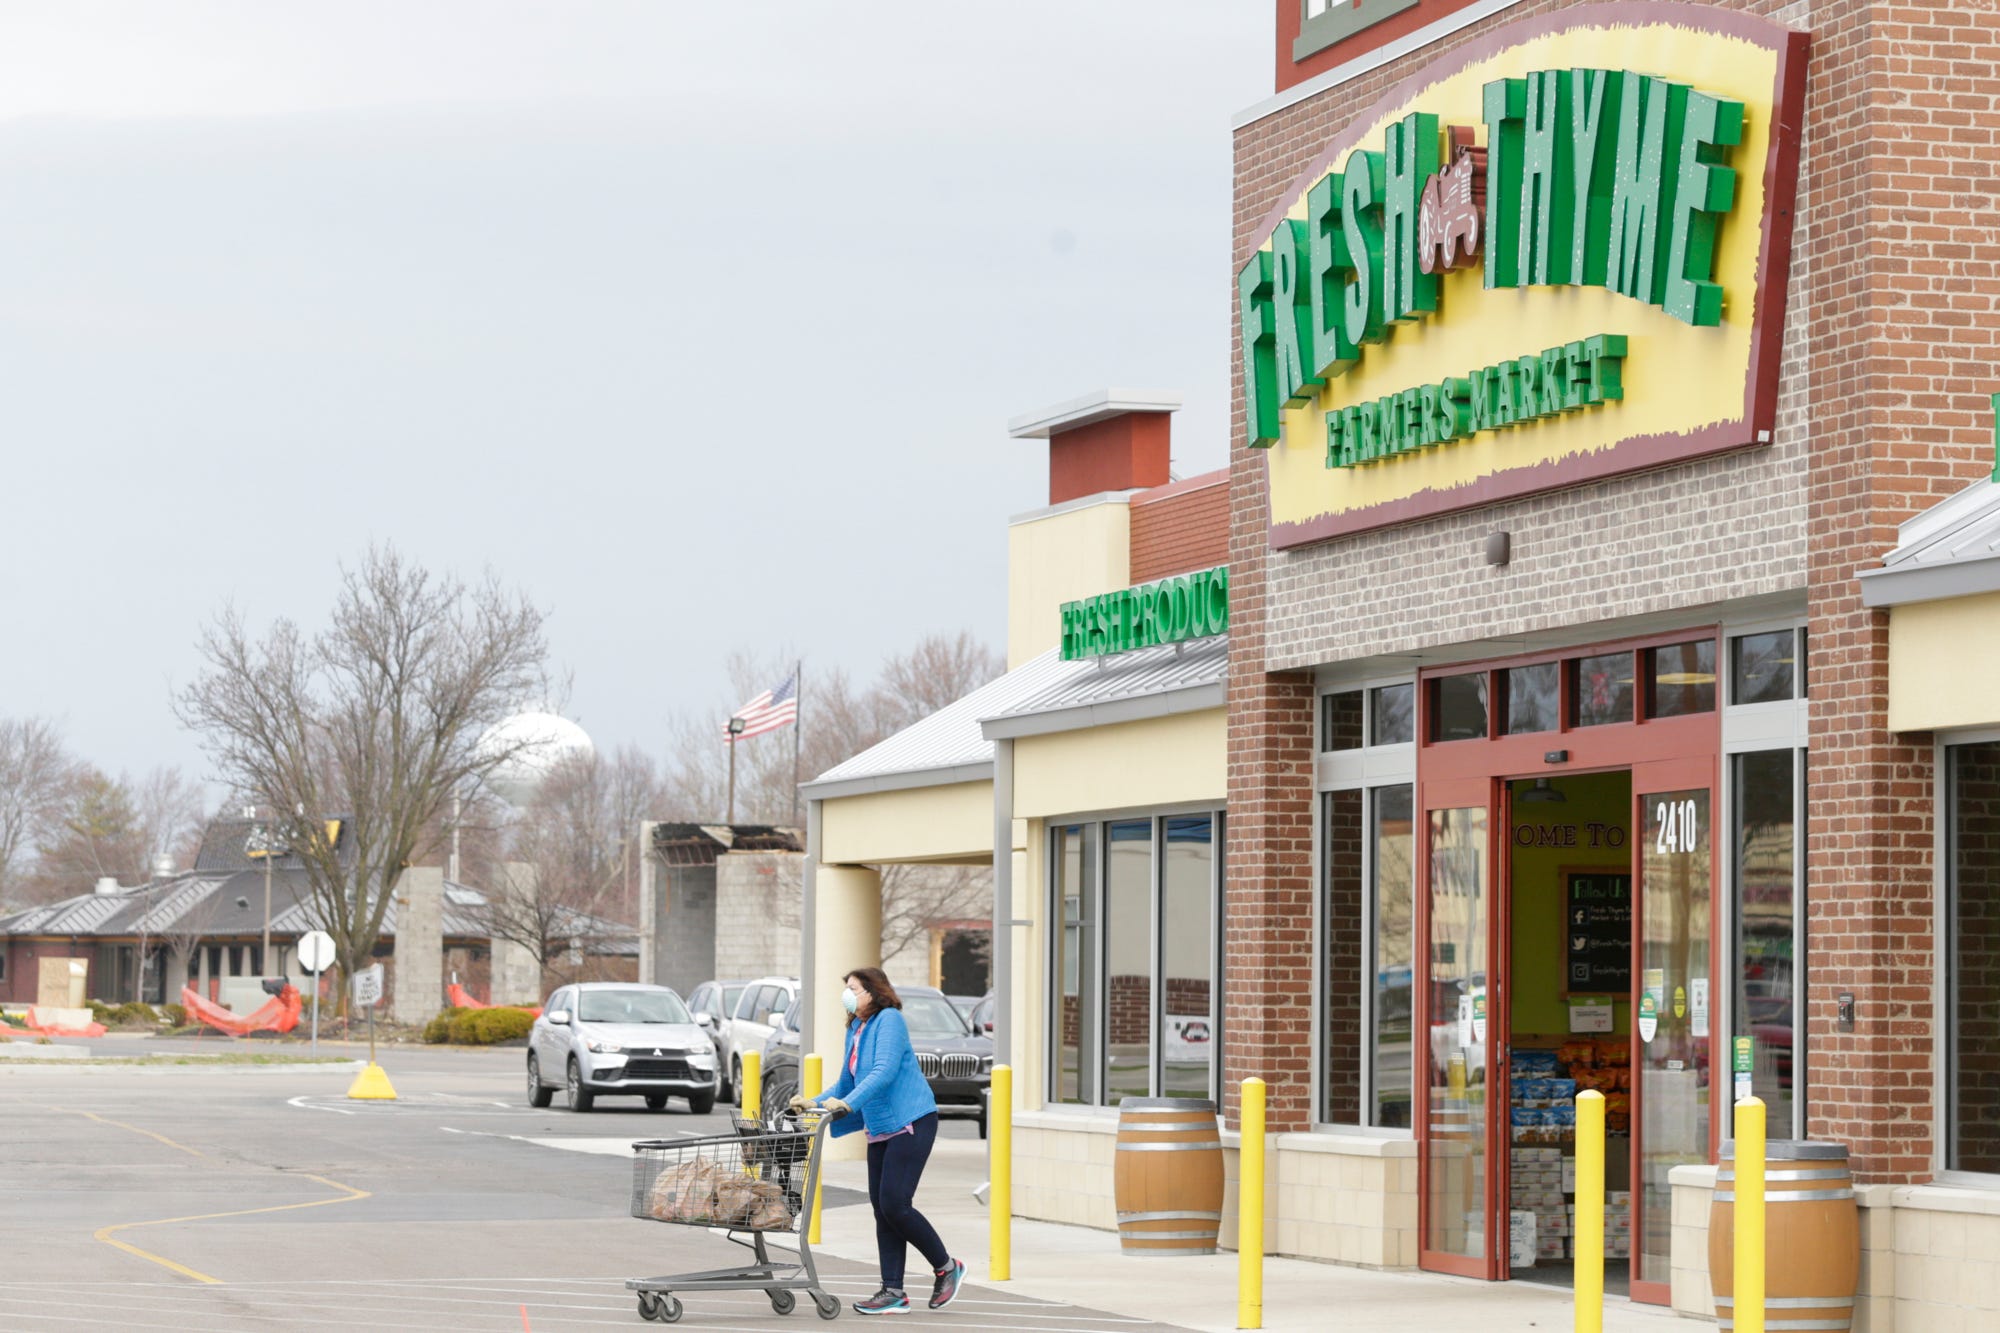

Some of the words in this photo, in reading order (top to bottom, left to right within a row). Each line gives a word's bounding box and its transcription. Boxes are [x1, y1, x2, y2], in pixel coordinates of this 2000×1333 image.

[1238, 112, 1438, 449] FRESH
[1482, 67, 1744, 326] THYME
[1326, 377, 1473, 469] FARMERS
[1469, 334, 1627, 433] MARKET
[1059, 590, 1129, 661] FRESH
[1128, 566, 1229, 649] PRODUC
[1512, 823, 1576, 849] OME
[1585, 821, 1625, 849] TO
[1657, 799, 1696, 854] 2410
